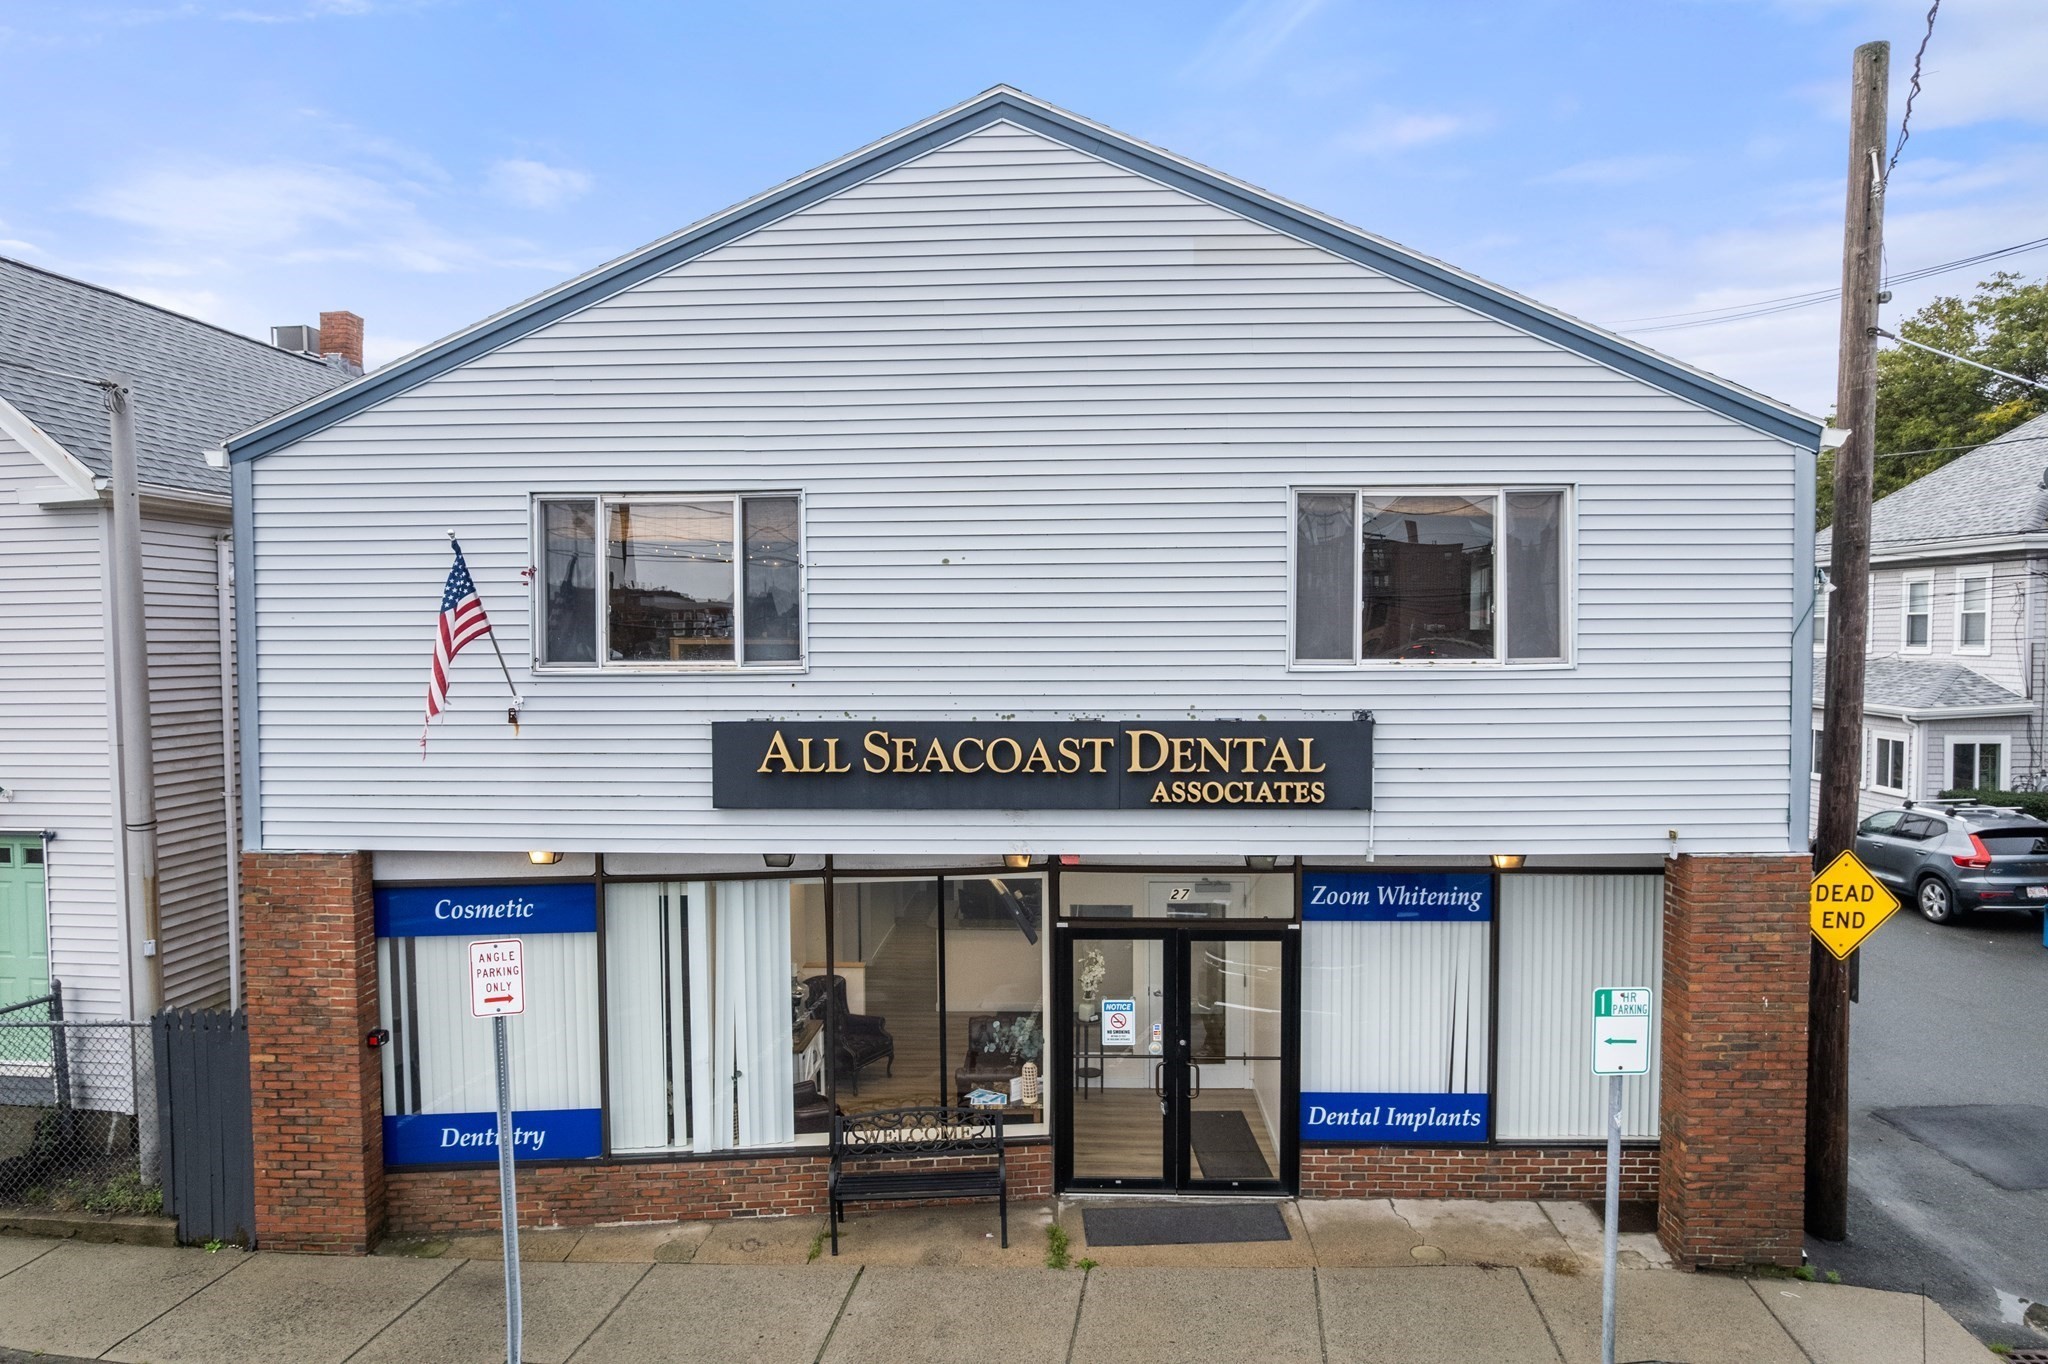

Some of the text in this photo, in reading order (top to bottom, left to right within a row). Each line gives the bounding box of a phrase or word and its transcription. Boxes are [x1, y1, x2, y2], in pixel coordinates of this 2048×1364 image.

[756, 730, 1326, 774] ALL SEACOAST DENTAL
[1150, 781, 1326, 803] ASSOCIATES
[1170, 888, 1190, 900] 27
[1310, 885, 1483, 912] Zoom Whitening
[1816, 884, 1874, 902] DEAD
[434, 897, 534, 919] Cosmetic
[1822, 911, 1865, 929] END
[479, 951, 515, 963] ANGLE
[476, 965, 519, 978] PARKING
[485, 981, 512, 993] ONLY
[1600, 992, 1637, 1015] 1 HR
[1613, 1004, 1648, 1014] PARKING
[1307, 1106, 1481, 1132] Dental Implants
[440, 1127, 546, 1151] Denttry
[864, 1126, 974, 1144] WELCOME
